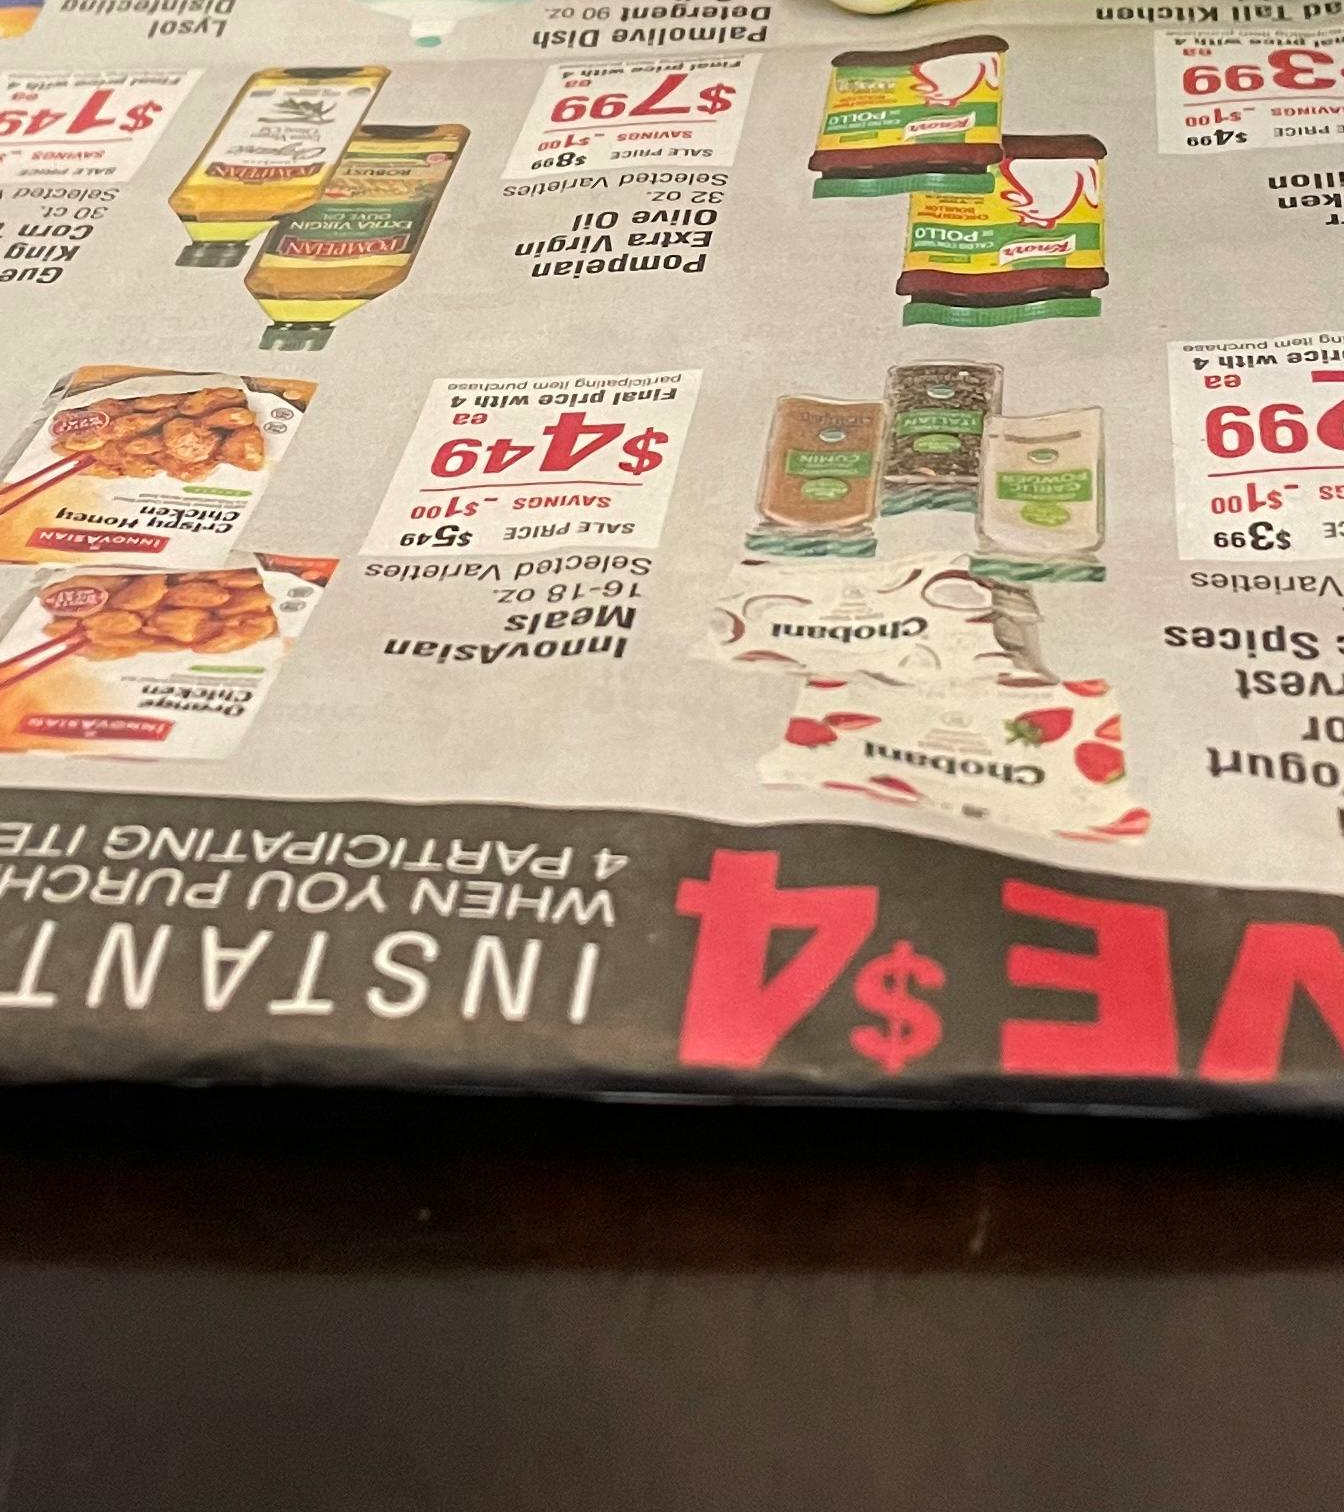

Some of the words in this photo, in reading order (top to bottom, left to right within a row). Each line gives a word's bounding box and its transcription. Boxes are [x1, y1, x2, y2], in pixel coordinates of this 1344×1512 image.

[544, 8, 574, 20] oz.
[582, 7, 610, 20] 90
[621, 4, 771, 21] Detergent
[1096, 6, 1218, 23] Kitchen
[1233, 4, 1292, 21] Tall
[147, 18, 227, 38] Lysol
[612, 25, 768, 46] Palmolive
[532, 29, 600, 49] Dish
[828, 111, 886, 125] POLLO
[343, 167, 411, 176] ROBUST
[619, 172, 729, 186] Selected
[13, 188, 120, 201] Selected
[502, 175, 608, 198] Varieties
[646, 191, 681, 202] oz.
[691, 191, 725, 203] 32
[41, 206, 68, 219] ct.
[74, 206, 108, 219] 30
[572, 211, 619, 231] Oil
[632, 209, 718, 226] Olive
[18, 223, 93, 240] Corn
[291, 220, 352, 230] VIRGIN
[358, 220, 413, 229] EXTRA
[627, 230, 713, 248] Extra
[914, 227, 978, 241] POLLO
[3, 243, 80, 261] King
[287, 239, 396, 256] POMPEIAN
[514, 234, 613, 258] Virgin
[1002, 240, 1071, 257] Knorr
[531, 254, 707, 279] Pompeian
[1193, 357, 1209, 370] 4
[1218, 354, 1279, 370] with
[1203, 374, 1241, 390] ea
[450, 396, 467, 407] 4
[474, 394, 530, 407] with
[538, 390, 604, 405] price
[615, 388, 677, 405] Final
[453, 413, 488, 427] ea
[55, 508, 139, 529] Honey
[139, 505, 241, 522] Chicken
[146, 518, 234, 533] Crispy
[365, 562, 500, 581] Varieties
[515, 555, 652, 579] Selected
[548, 580, 642, 603] 16-18
[1190, 572, 1342, 596] Varieties
[493, 587, 536, 604] oz.
[504, 605, 636, 635] Meals
[770, 617, 928, 644] Chobani
[383, 636, 627, 665] InnovAsian
[1163, 626, 1320, 660] Spices
[140, 683, 254, 703] Chicken
[864, 741, 1045, 785] Chobani
[103, 825, 574, 879] PARTICIPATING
[593, 847, 630, 881] 4
[247, 869, 387, 913] YOU
[410, 878, 615, 927] WHEN
[676, 848, 946, 1074] $4
